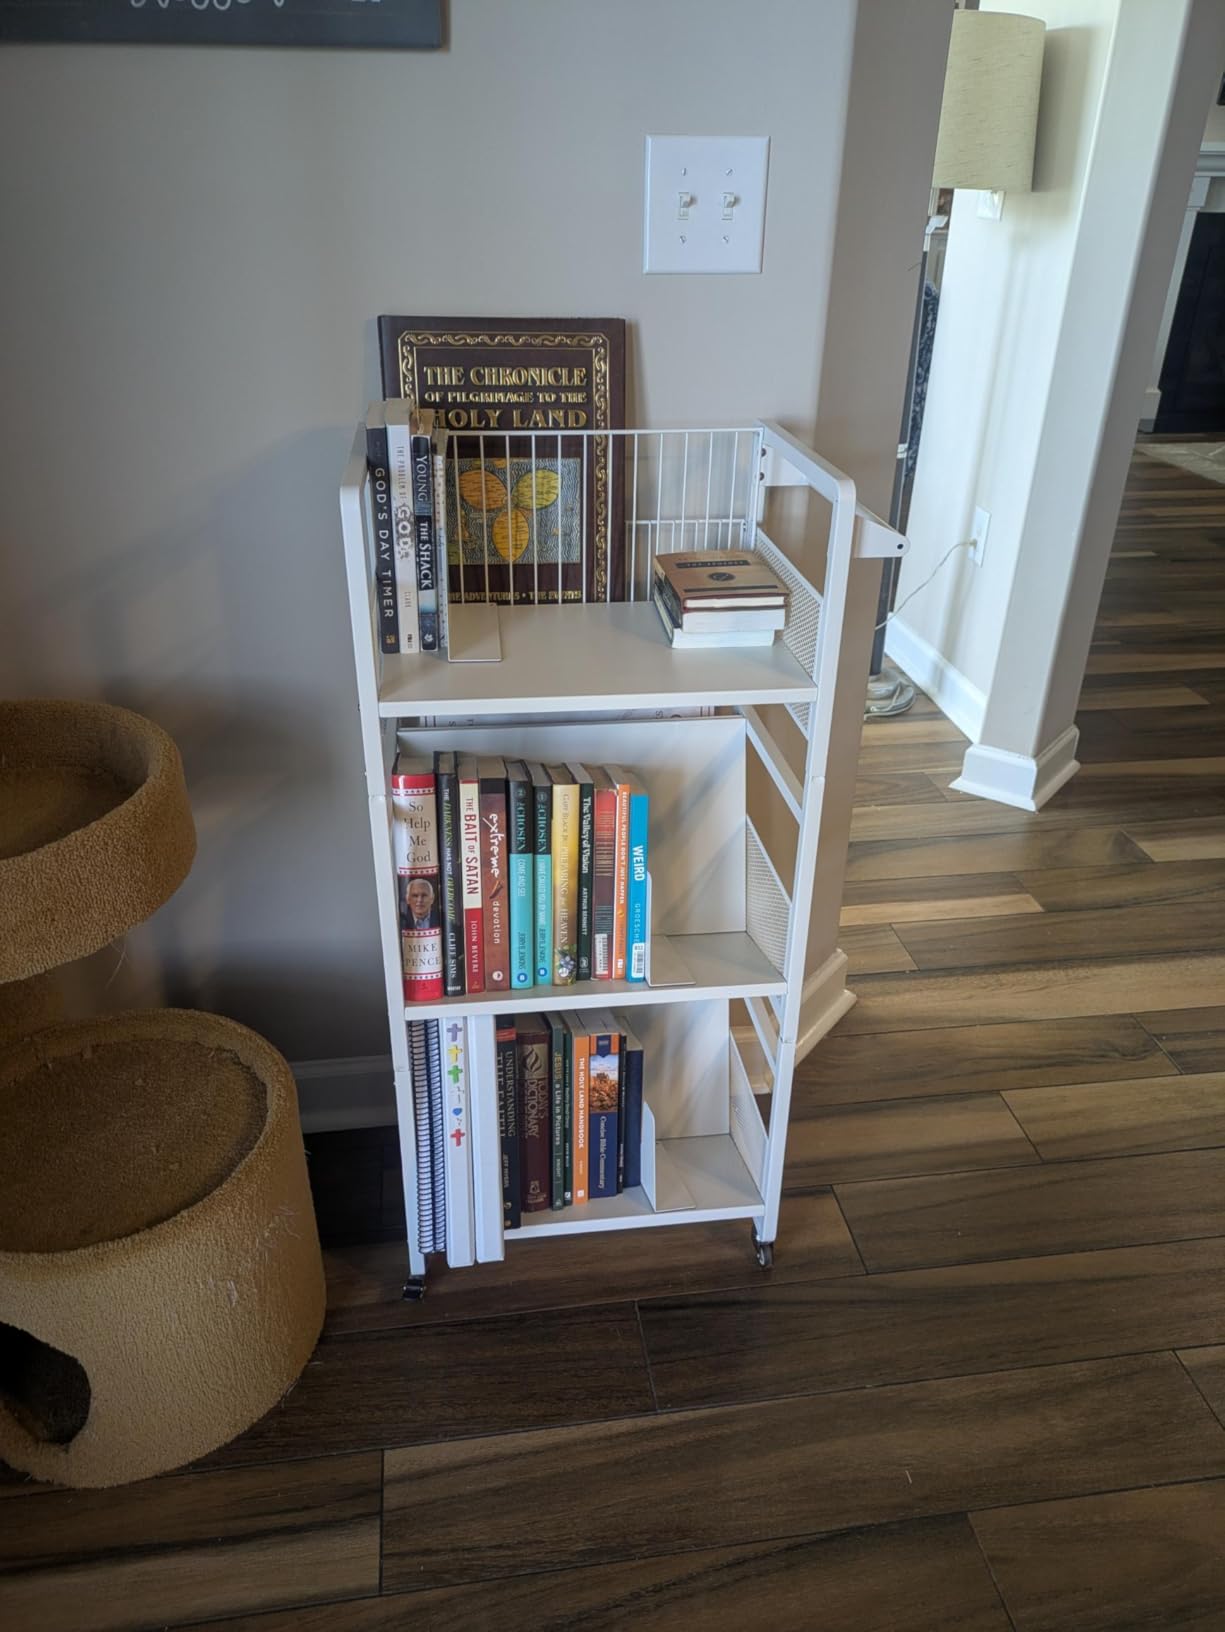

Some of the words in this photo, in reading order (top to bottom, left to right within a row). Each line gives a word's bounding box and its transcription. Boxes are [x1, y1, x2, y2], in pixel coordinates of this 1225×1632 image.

[423, 366, 465, 386] THE
[470, 366, 588, 387] CHRONICLE
[424, 391, 444, 403] OF
[448, 391, 534, 403] PILGRIMAGE
[537, 391, 557, 403] TO
[559, 391, 588, 403] THE
[433, 408, 502, 428] HOLY
[512, 408, 588, 429] LAND
[416, 455, 428, 502] YOUNG
[375, 467, 388, 520] GOD'S
[397, 506, 412, 548] GOD
[419, 521, 429, 541] THE
[378, 529, 390, 560] DAY
[420, 543, 432, 589] SHACK
[382, 569, 394, 618] TIMER
[408, 800, 424, 812] So
[465, 797, 474, 812] THE
[583, 797, 591, 813] The
[404, 816, 431, 832] Help
[443, 801, 452, 846] DARKNESS
[464, 813, 477, 843] BAIT
[516, 807, 526, 851] CHOSEN
[538, 808, 547, 852] CHOSEN
[581, 813, 591, 841] Valley
[409, 835, 427, 846] Me
[468, 845, 475, 854] OF
[482, 813, 505, 878] extreme
[406, 850, 431, 863] God
[582, 848, 590, 874] Vision
[633, 845, 645, 881] WEIRD
[466, 856, 479, 896] SATAN
[560, 846, 569, 896] PREPARING
[447, 876, 456, 922] OVERCOME
[470, 920, 478, 941] JOHN
[492, 900, 501, 944] devotion
[560, 908, 569, 944] HEAVEN
[408, 943, 437, 953] MIKE
[448, 932, 457, 956] CLIFF
[406, 956, 440, 967] PENCE
[449, 958, 457, 979] SIMS
[471, 945, 479, 973] BEVERE
[505, 1051, 515, 1137] UNDERSTANDING
[527, 1080, 539, 1138] DICTIONARY
[599, 1115, 607, 1138] Concise
[599, 1138, 607, 1153] Bible
[598, 1153, 607, 1189] Commentary
